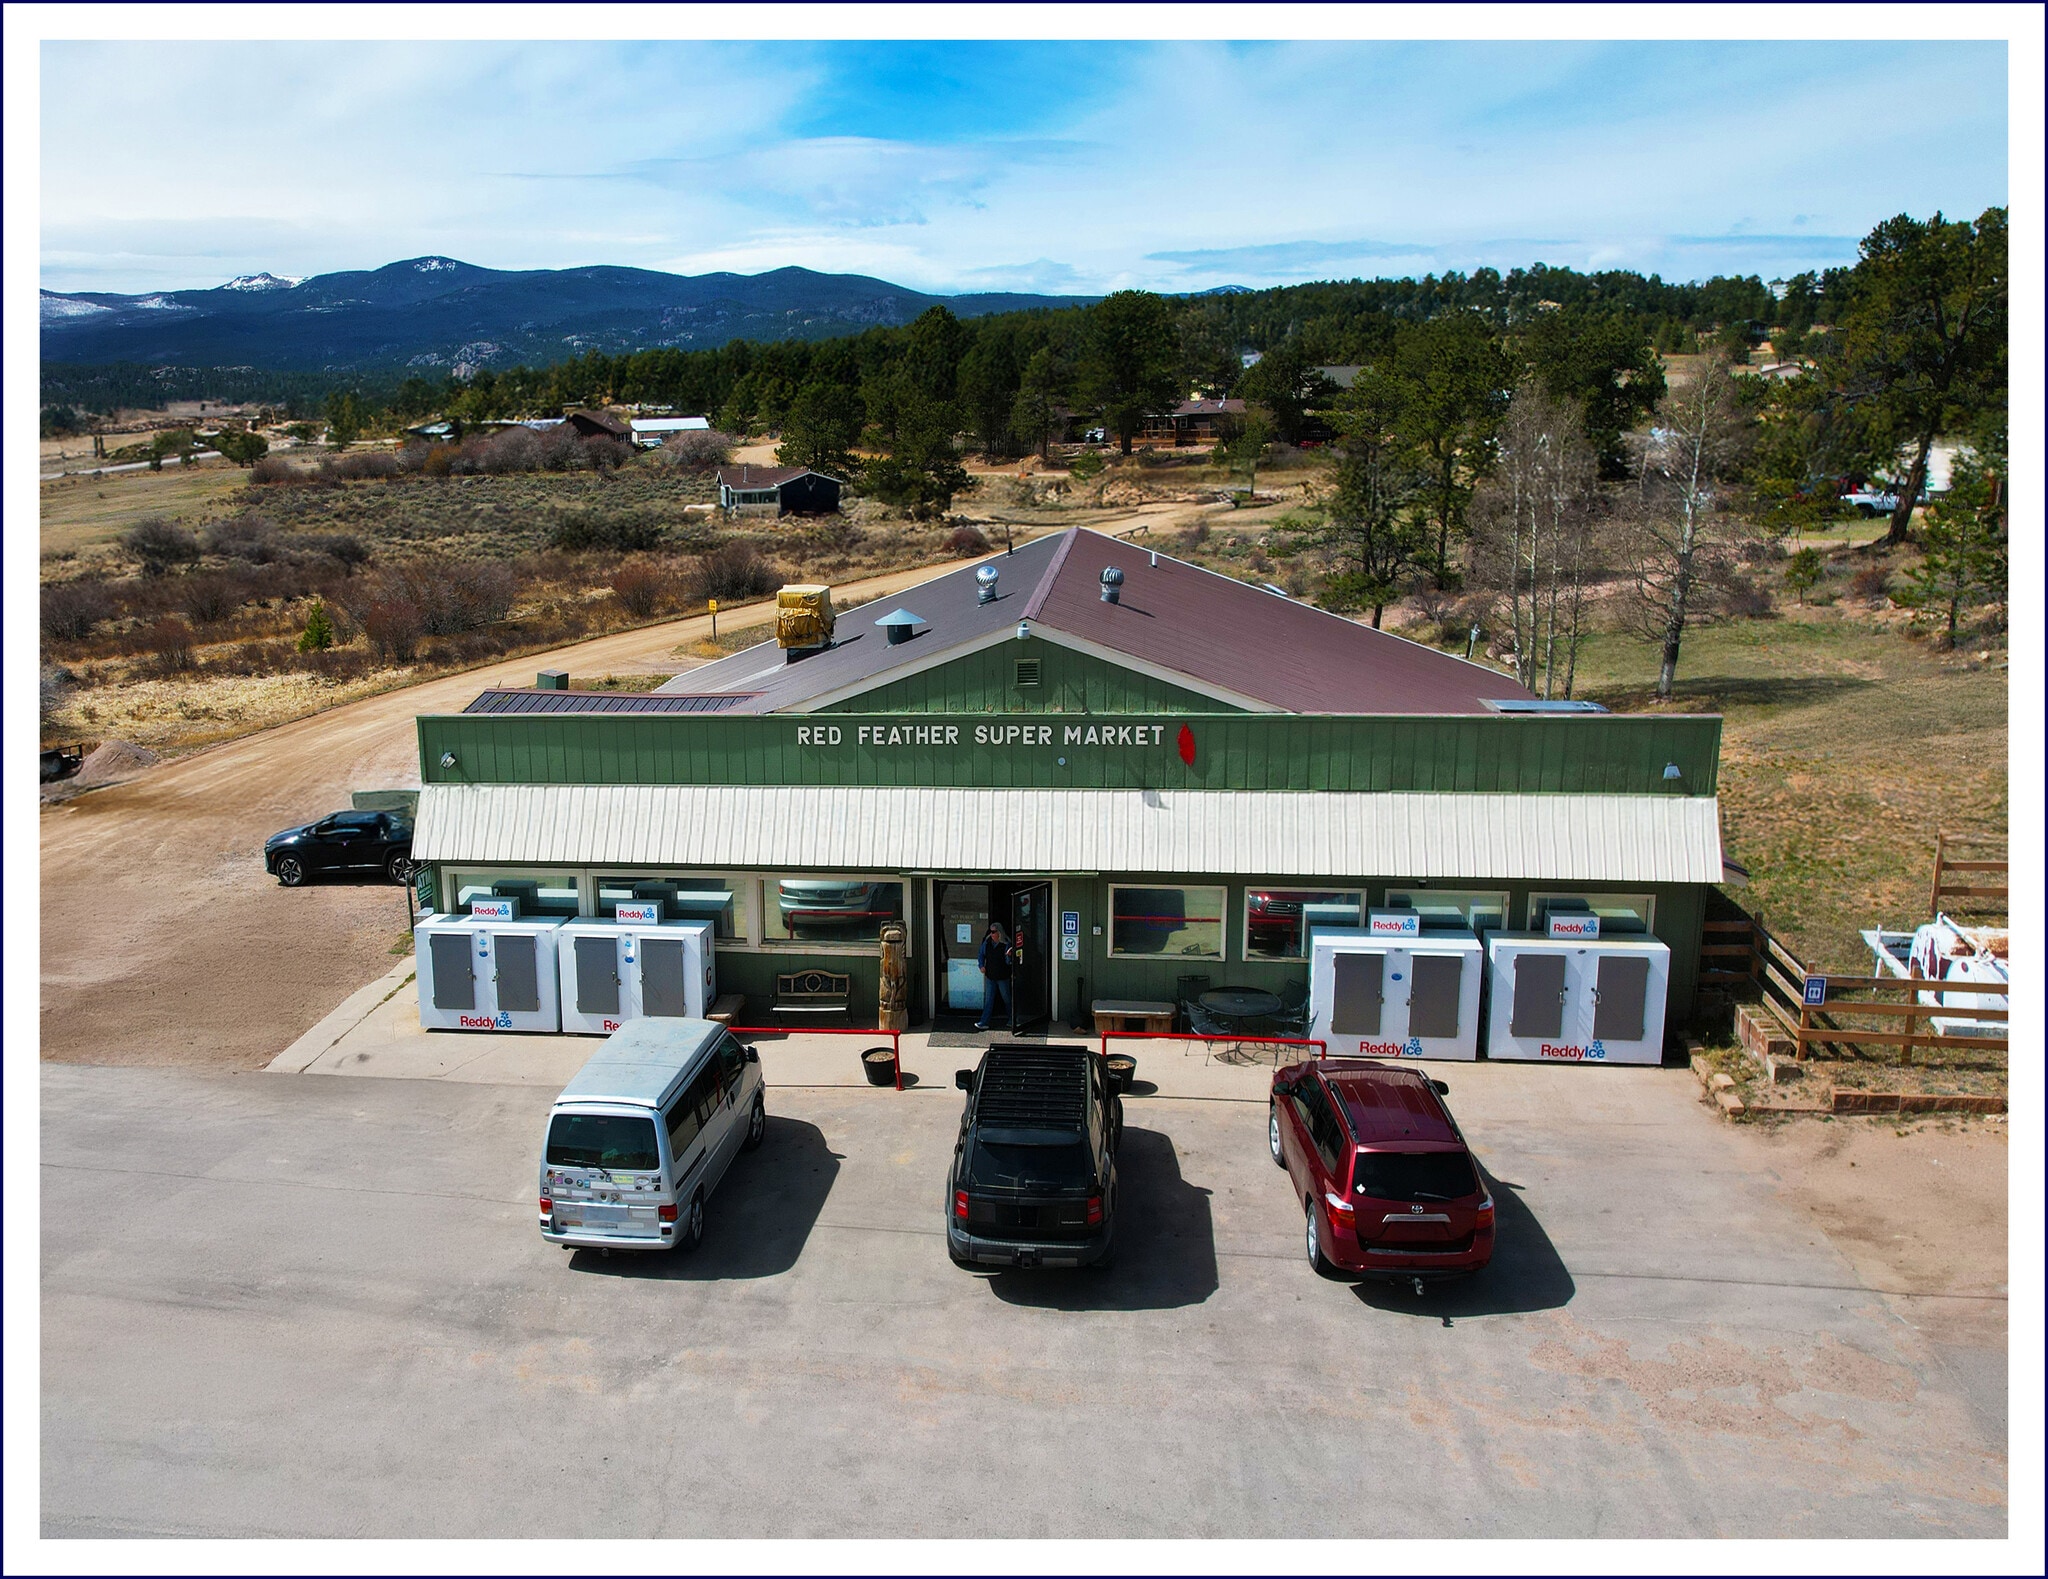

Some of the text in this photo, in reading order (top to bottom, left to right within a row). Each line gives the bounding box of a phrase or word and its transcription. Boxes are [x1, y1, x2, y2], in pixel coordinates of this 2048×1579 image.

[797, 725, 1165, 745] RED FEATHER SUPER MARKET
[417, 869, 432, 891] ATM
[460, 1014, 513, 1030] ReddyIce
[1359, 1040, 1423, 1056] ReddyIce
[1541, 1043, 1606, 1061] ReddyIce
